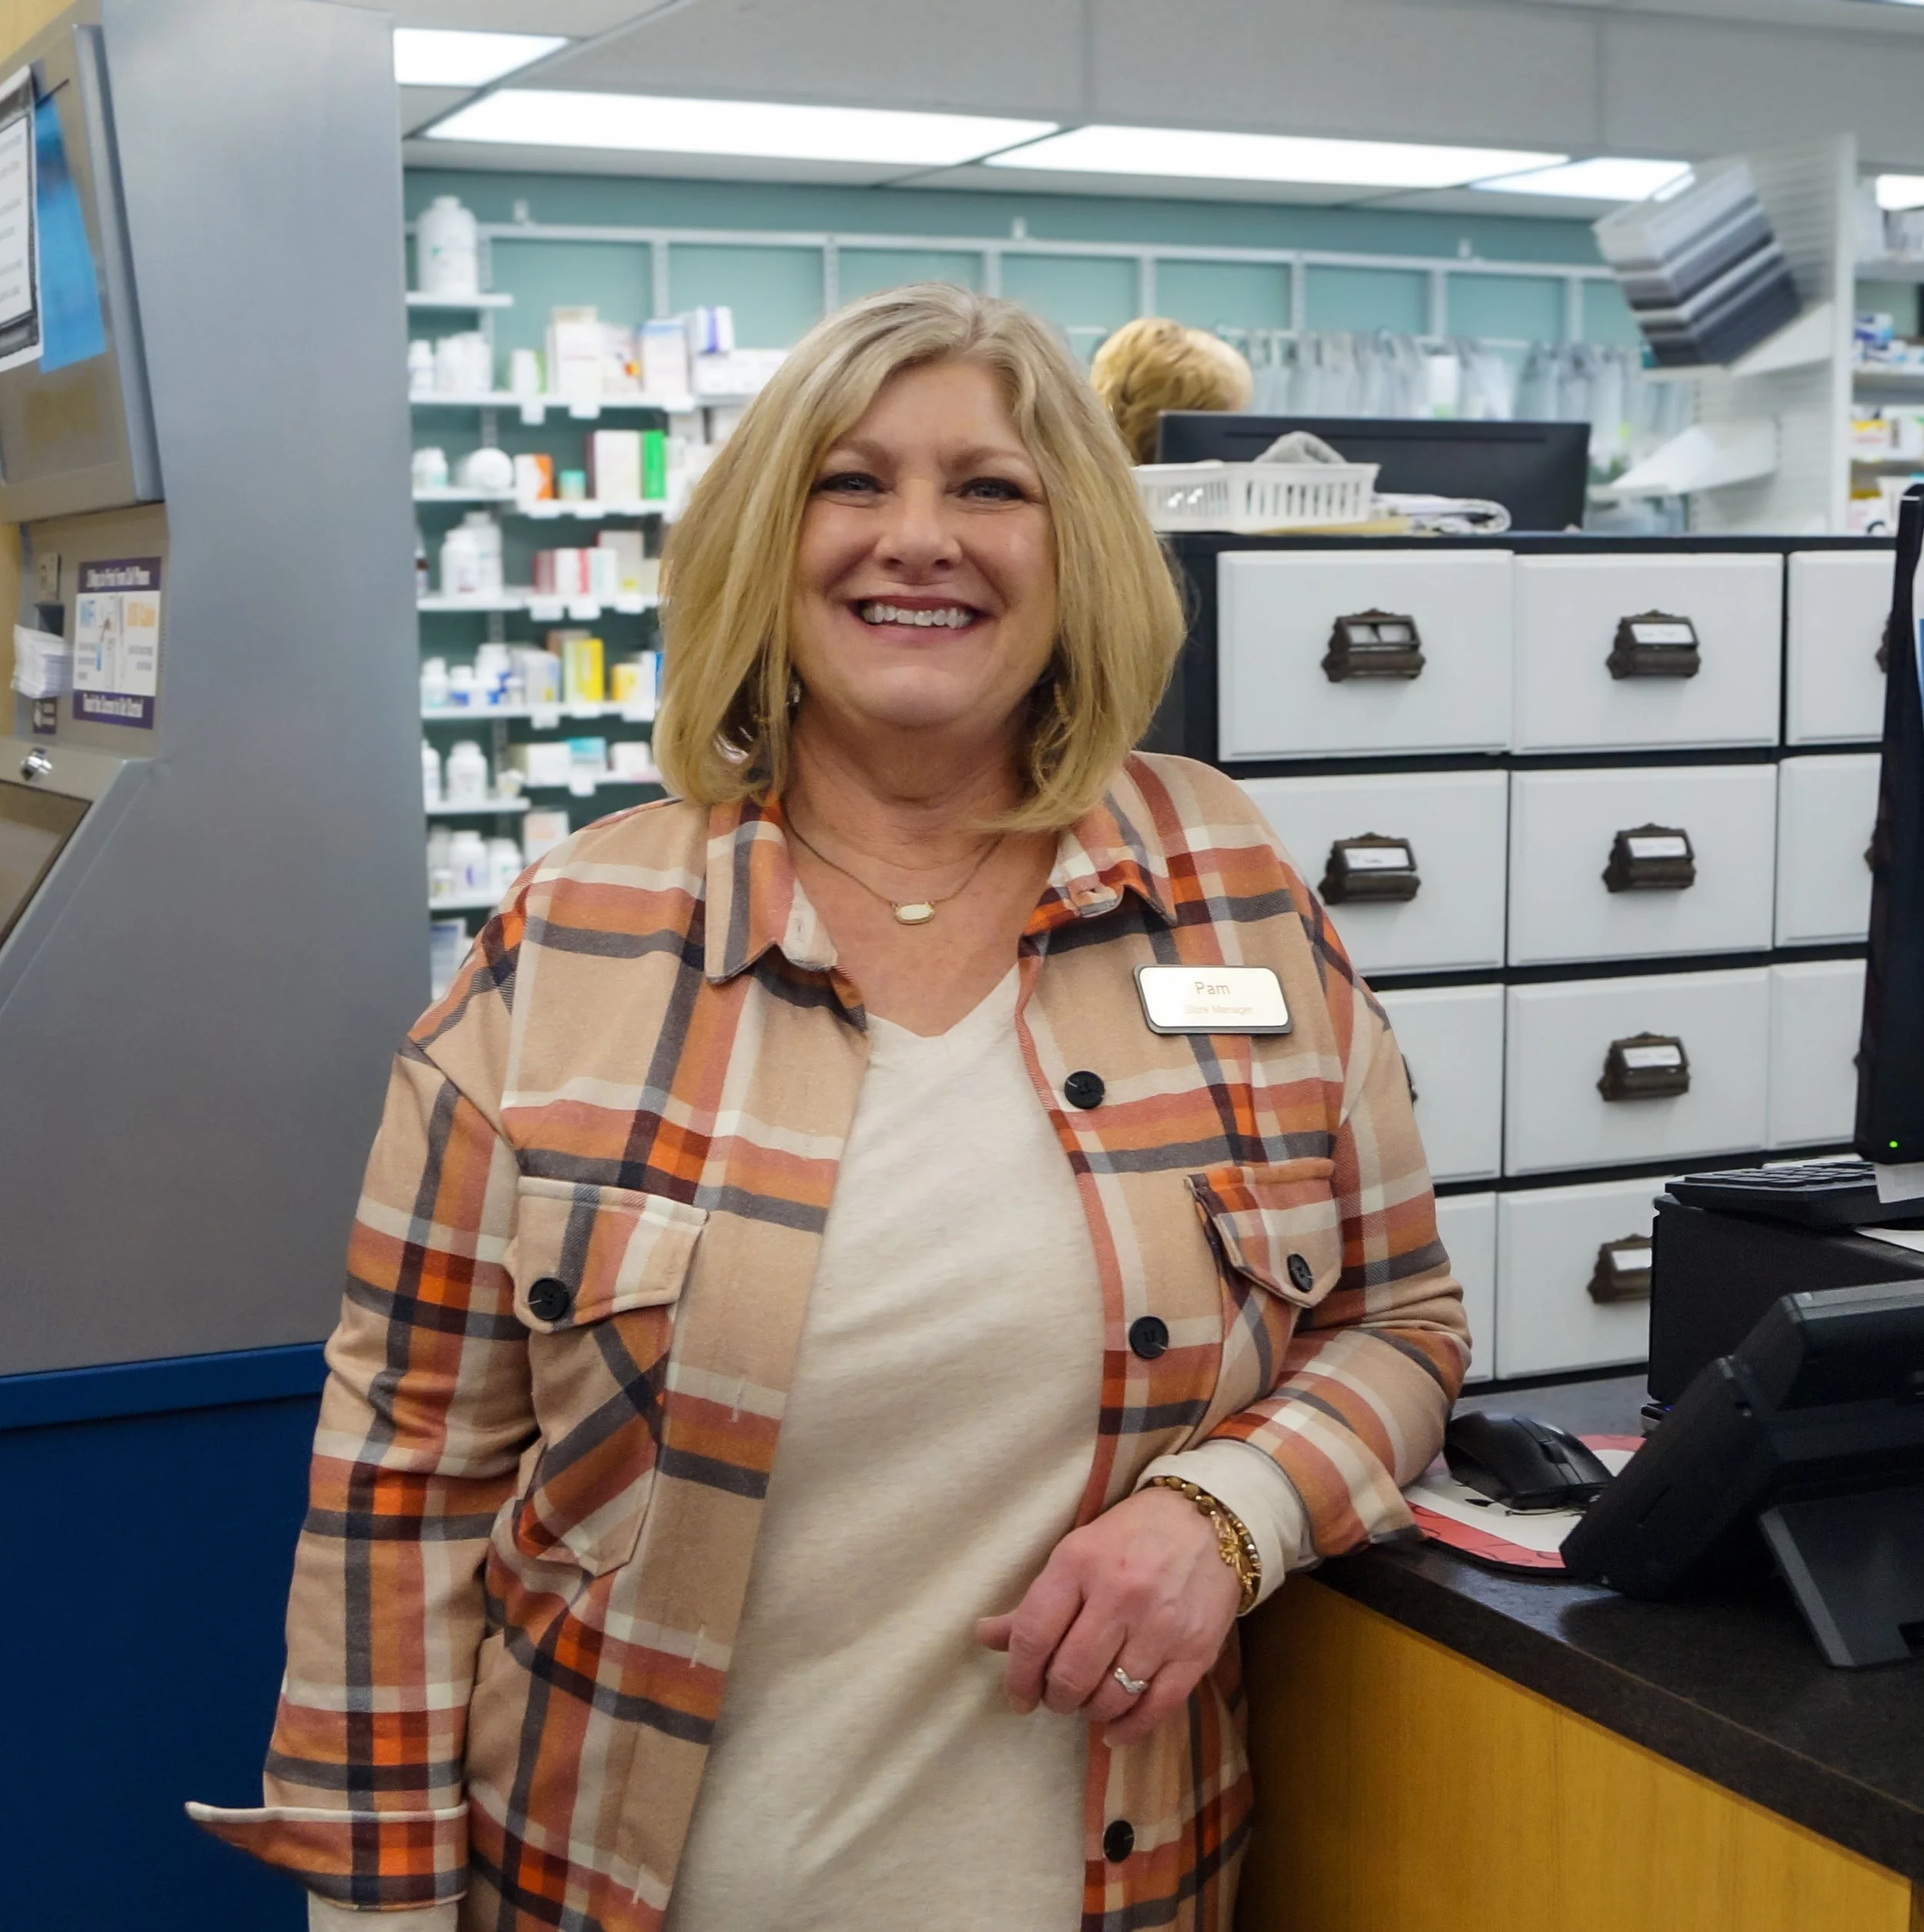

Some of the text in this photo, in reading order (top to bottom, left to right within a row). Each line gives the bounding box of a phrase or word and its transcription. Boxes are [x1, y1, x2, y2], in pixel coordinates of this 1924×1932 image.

[1194, 981, 1231, 995] Pam
[1186, 1004, 1254, 1016] Store Manager
